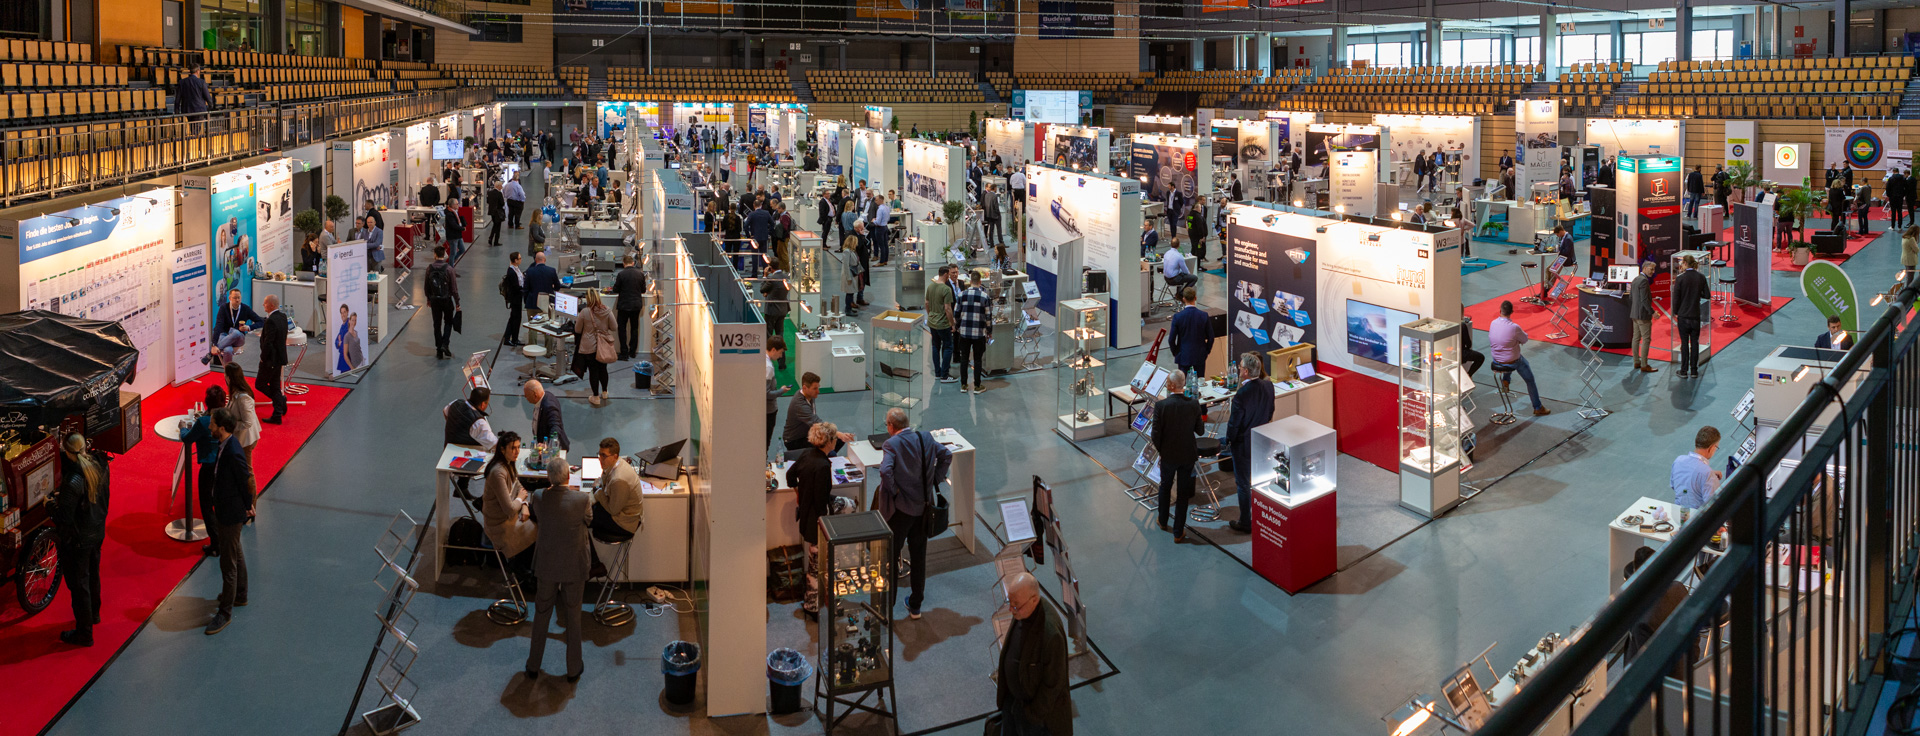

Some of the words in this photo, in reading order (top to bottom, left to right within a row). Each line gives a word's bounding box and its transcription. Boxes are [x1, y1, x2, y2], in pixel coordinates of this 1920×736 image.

[1569, 23, 1574, 31] L
[1657, 19, 1664, 27] M
[25, 229, 40, 239] Finde
[40, 226, 48, 236] die
[48, 223, 64, 234] besten
[1233, 238, 1241, 246] We
[1241, 241, 1259, 250] engineer,
[1436, 238, 1447, 248] W3
[184, 249, 203, 259] KARRIERE
[338, 249, 354, 260] iperdi
[1233, 246, 1258, 256] manufacture
[1233, 253, 1252, 261] assemble
[1242, 262, 1259, 270] machine
[1396, 280, 1426, 289] WETZLAR
[1825, 285, 1850, 314] THM
[720, 333, 744, 347] W3
[1253, 497, 1269, 511] Pollen
[1268, 505, 1288, 521] Monitor
[1261, 510, 1281, 527] BAA500
